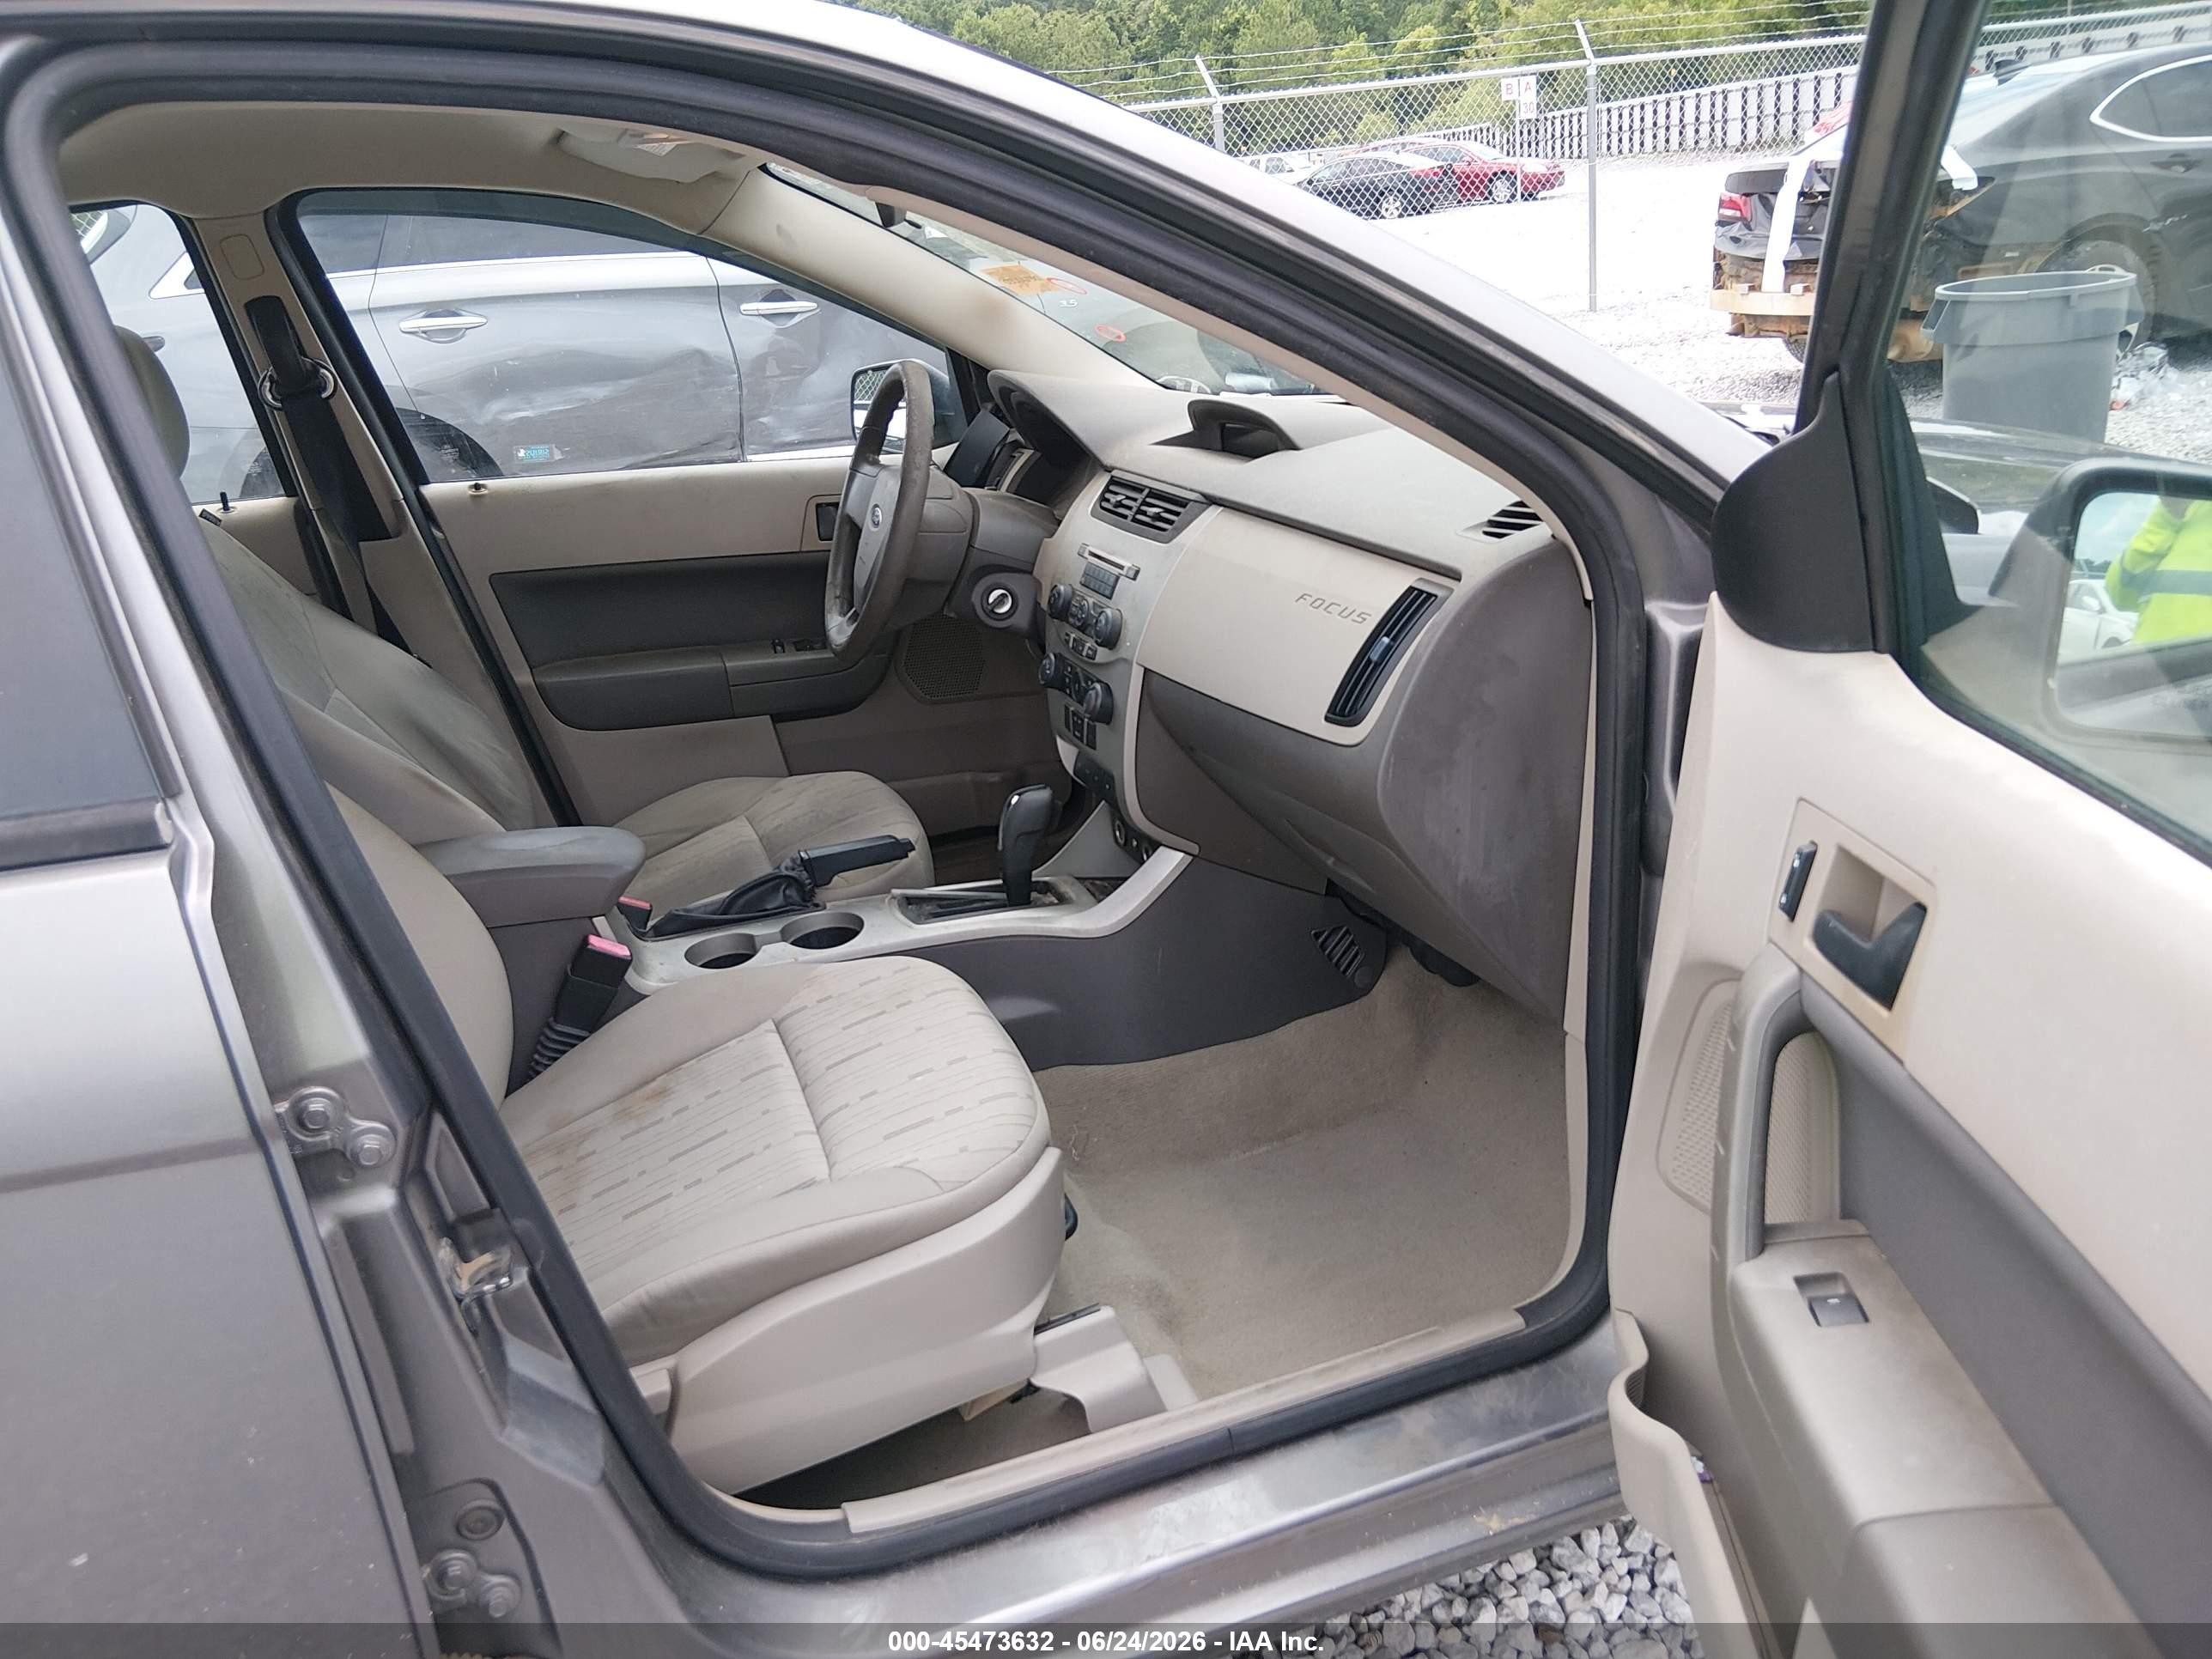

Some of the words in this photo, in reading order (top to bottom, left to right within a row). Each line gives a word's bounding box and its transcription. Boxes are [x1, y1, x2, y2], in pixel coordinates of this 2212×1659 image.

[1505, 82, 1513, 95] B
[1523, 82, 1533, 94] A
[1522, 101, 1534, 114] 30
[1295, 593, 1372, 624] FOCUS
